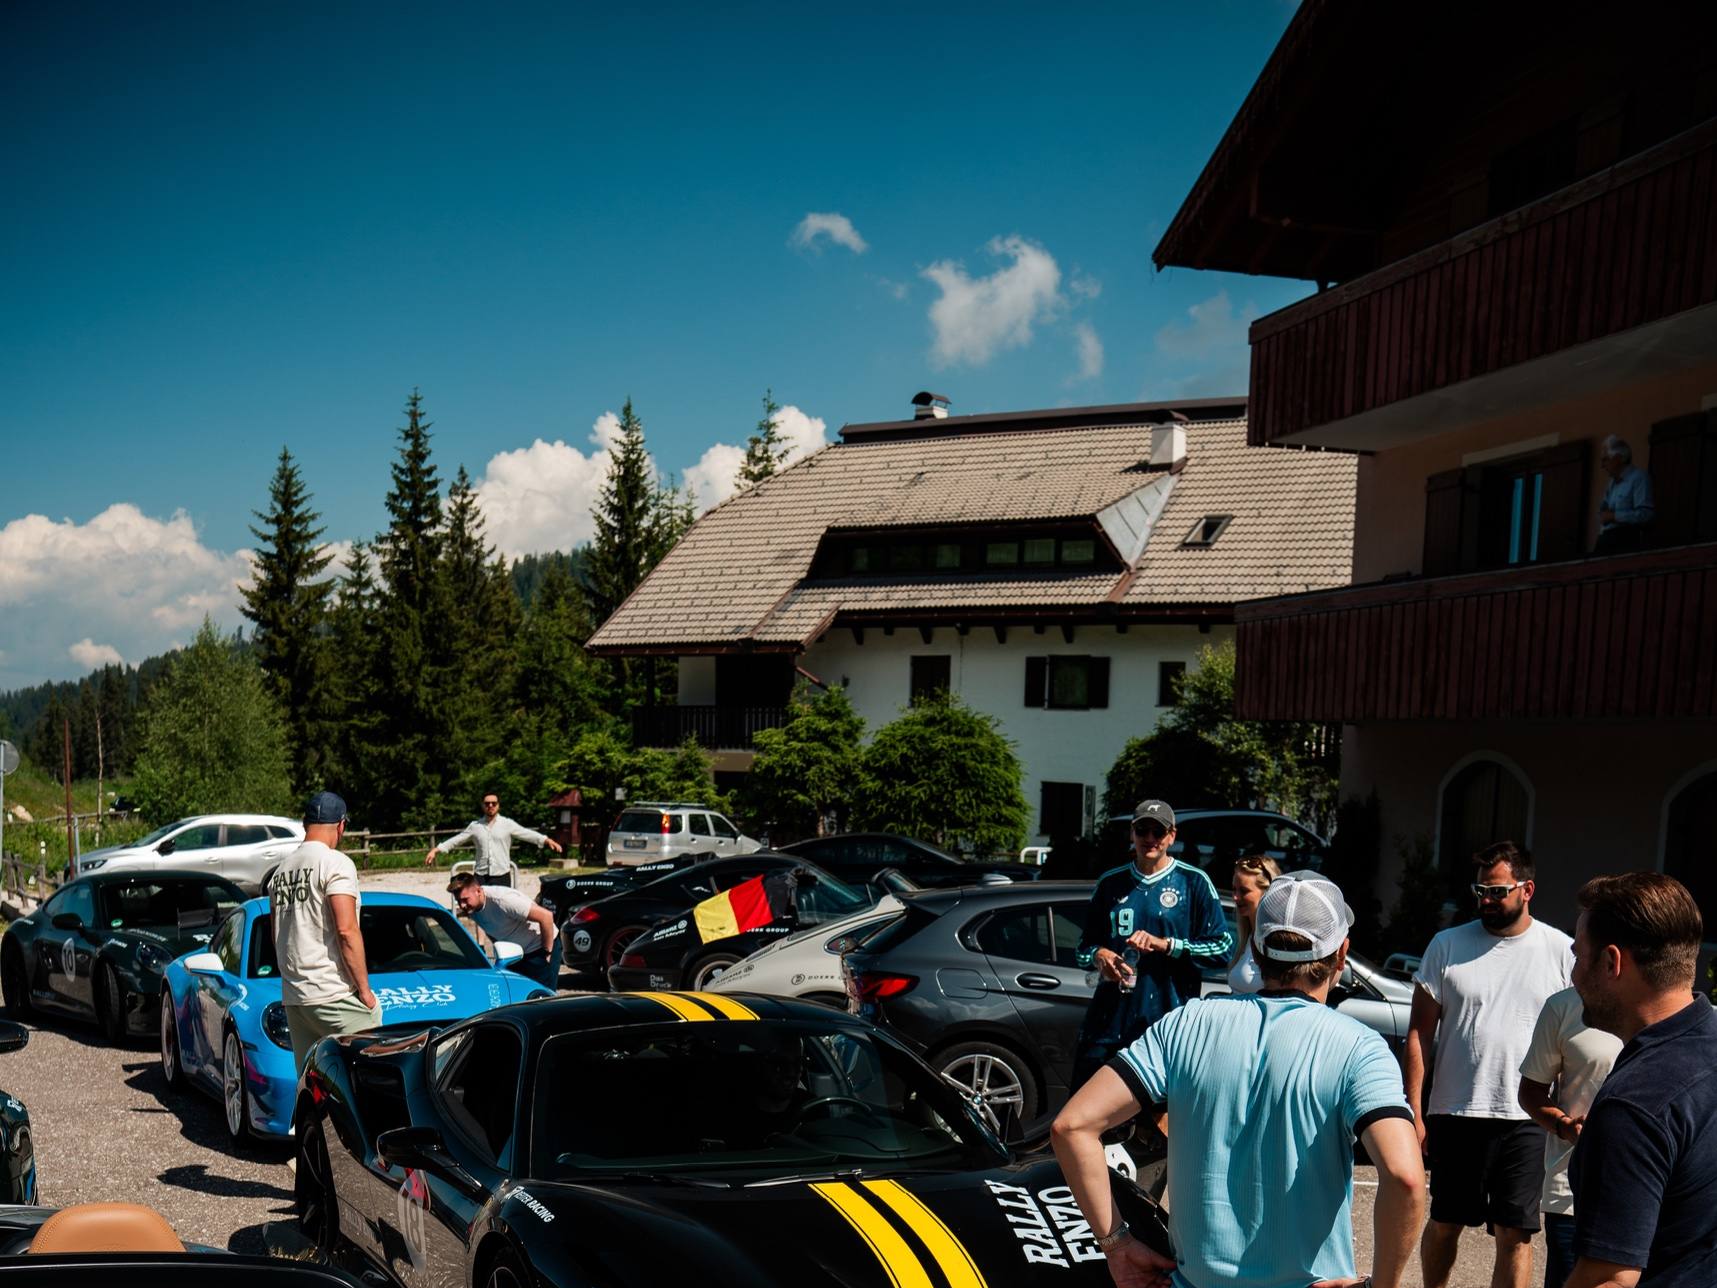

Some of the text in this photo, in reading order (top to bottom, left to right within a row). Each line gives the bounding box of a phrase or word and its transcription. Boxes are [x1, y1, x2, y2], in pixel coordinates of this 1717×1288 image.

[1110, 908, 1135, 937] 19
[575, 936, 589, 947] 49
[64, 946, 76, 973] 10
[526, 1199, 555, 1223] RACING
[984, 1179, 1070, 1269] RALLY
[1037, 1186, 1108, 1263] ENZO
